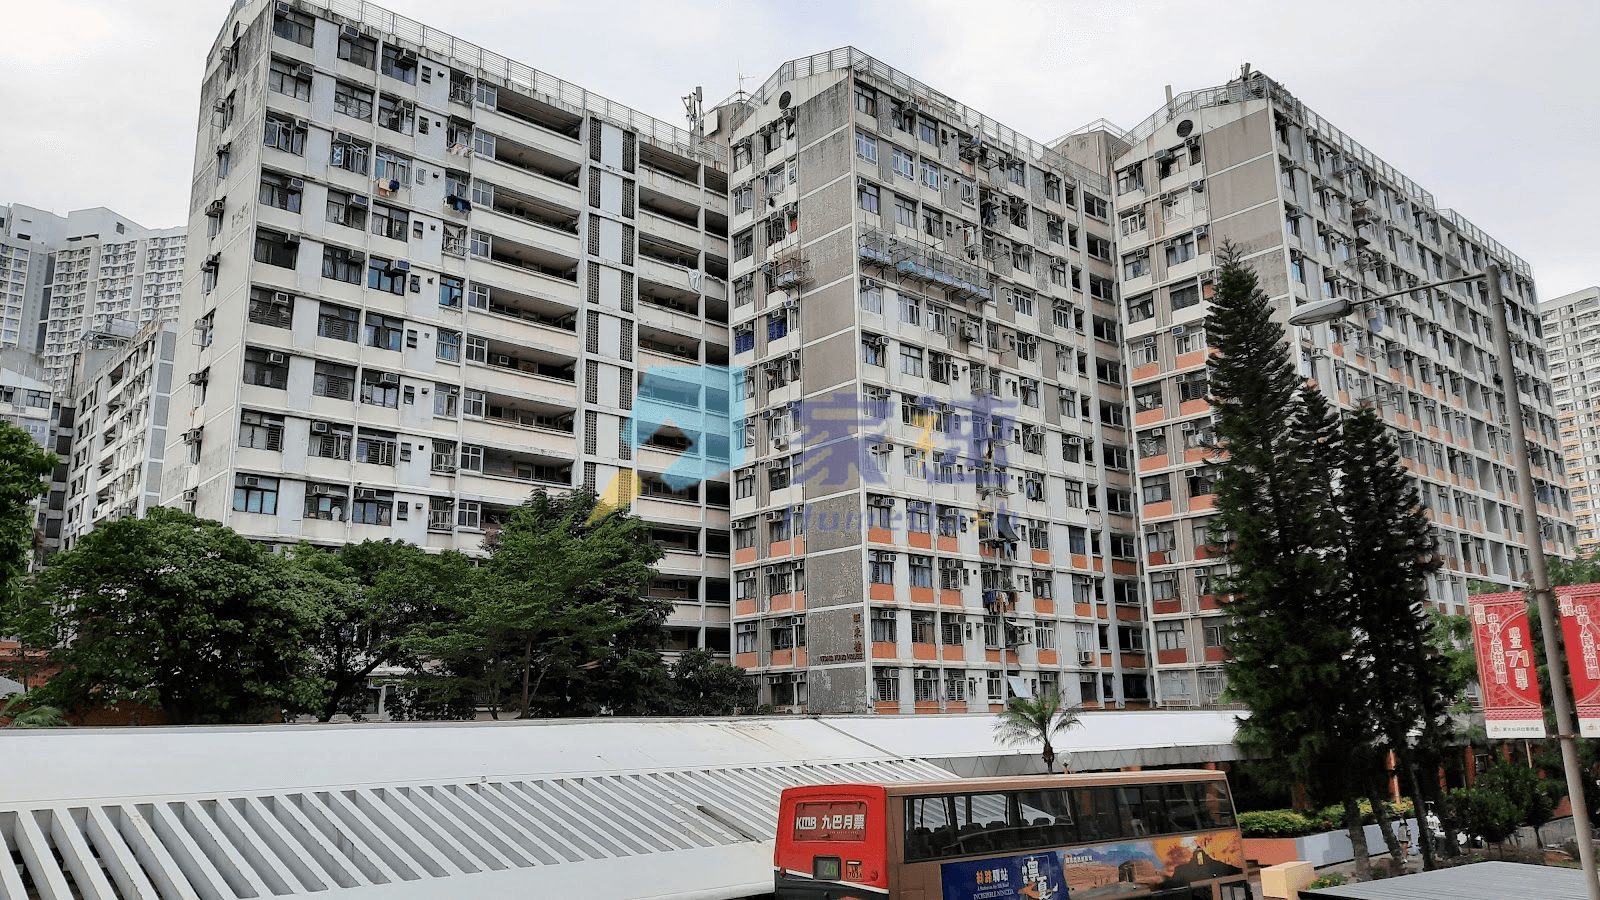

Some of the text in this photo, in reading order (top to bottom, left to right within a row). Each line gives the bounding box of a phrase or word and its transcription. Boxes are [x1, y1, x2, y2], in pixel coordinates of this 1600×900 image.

[1487, 613, 1508, 685] 中華人民共和國
[1575, 604, 1600, 680] 中華人民共和國
[796, 814, 864, 830] KMB 九巴月票
